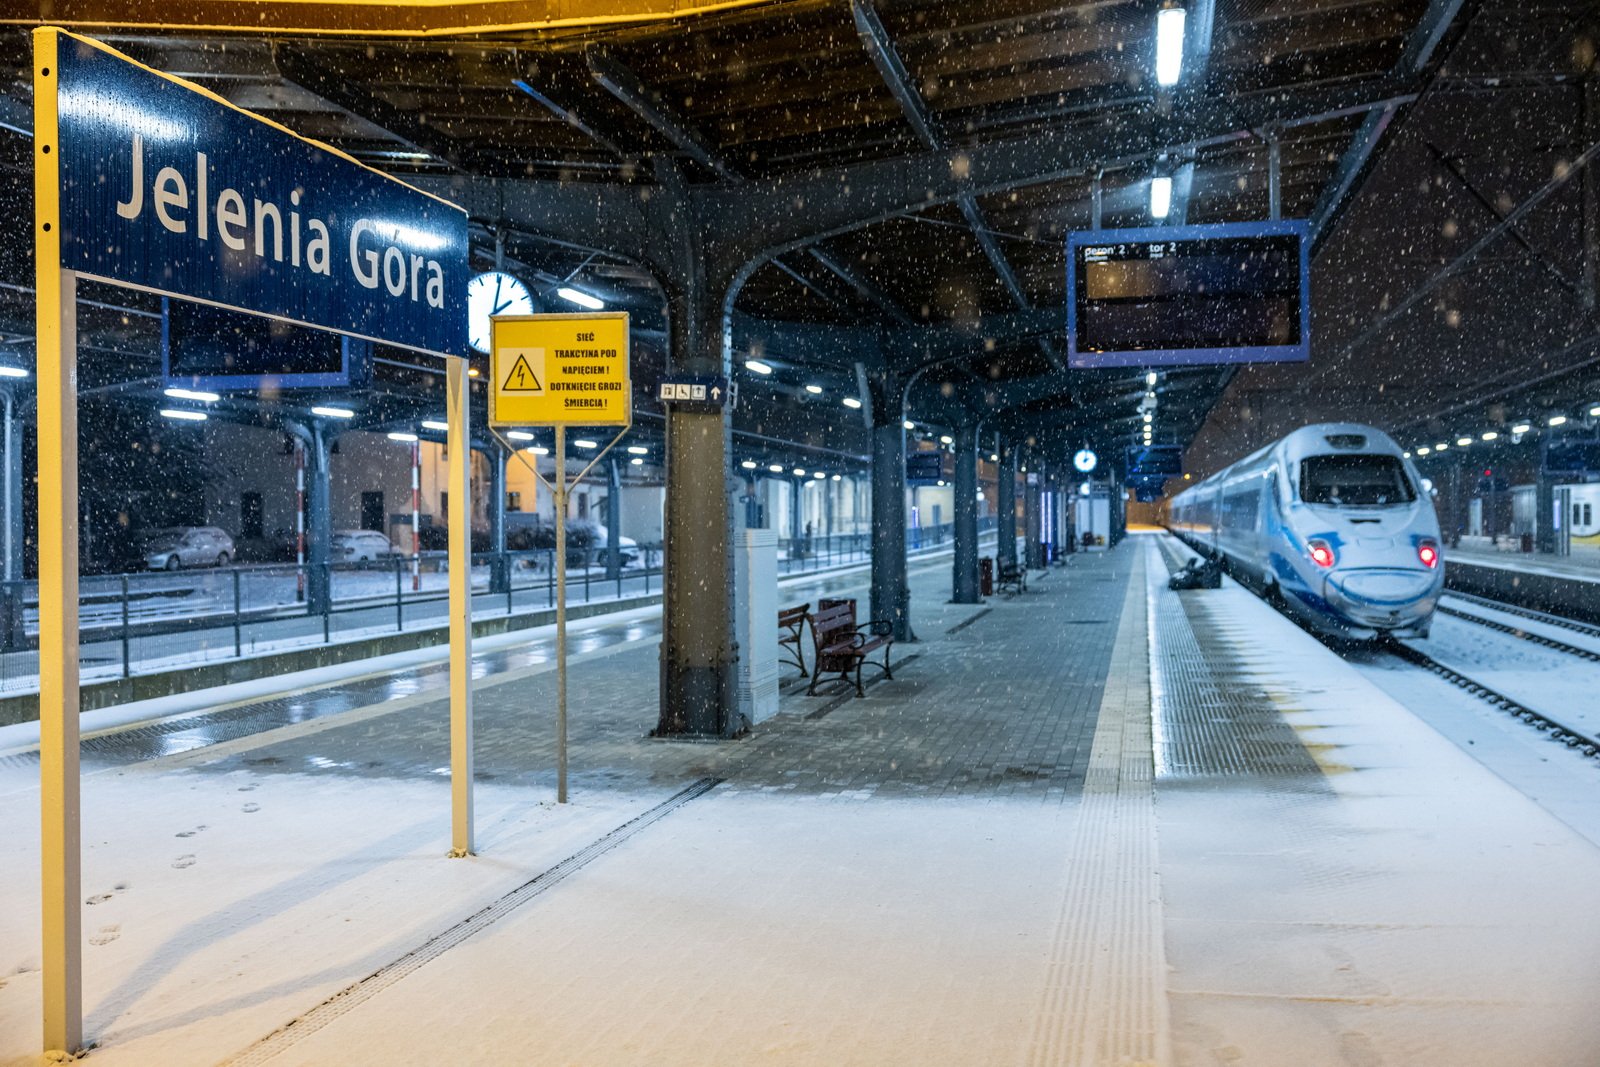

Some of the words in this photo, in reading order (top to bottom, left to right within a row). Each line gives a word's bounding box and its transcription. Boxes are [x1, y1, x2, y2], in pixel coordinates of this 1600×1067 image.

[116, 132, 331, 277] Jelenia
[349, 217, 444, 309] Góra
[1119, 245, 1126, 254] 2
[1170, 242, 1176, 252] 2
[576, 332, 595, 342] SIEĆ
[554, 350, 599, 358] TRAKCYJNA
[600, 350, 617, 358] POD
[598, 382, 622, 390] GROZI
